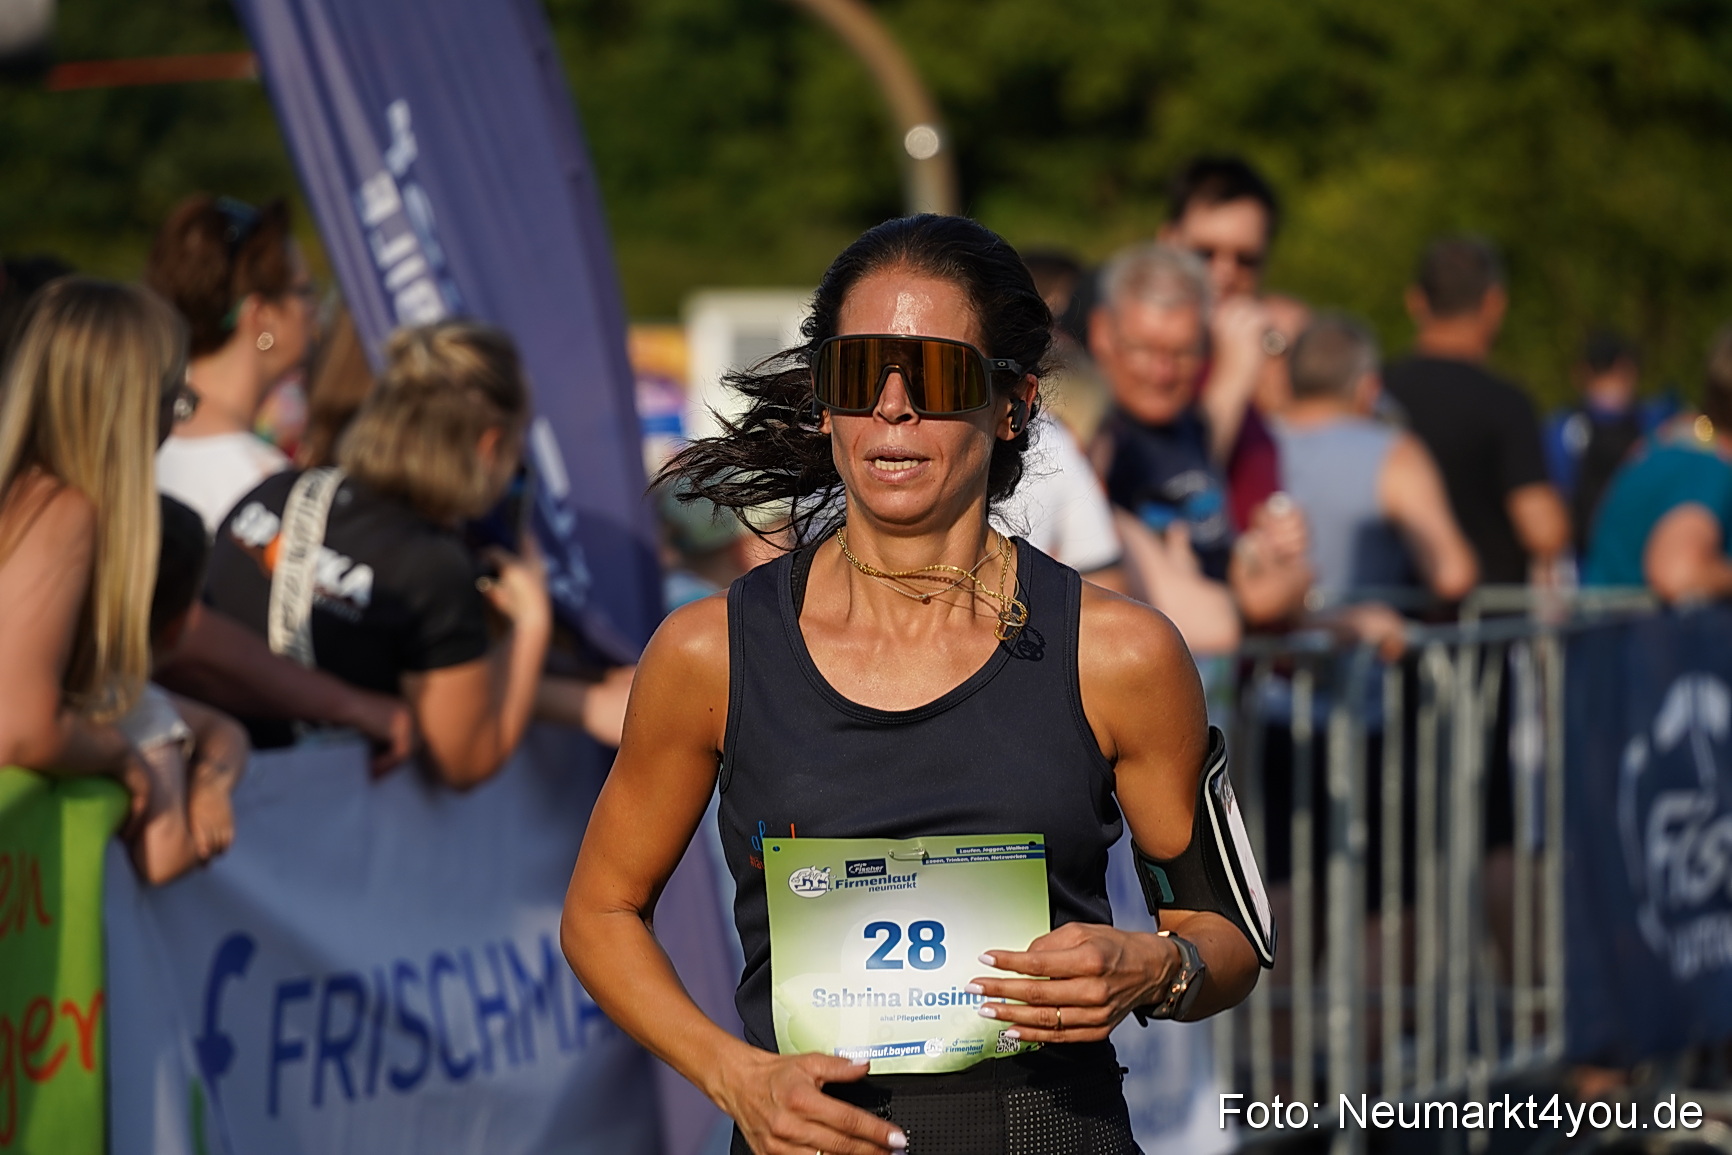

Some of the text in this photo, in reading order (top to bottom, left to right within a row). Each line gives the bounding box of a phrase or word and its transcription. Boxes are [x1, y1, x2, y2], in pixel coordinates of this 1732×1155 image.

[835, 873, 917, 889] Firmenlauf
[869, 881, 917, 892] neumarkt
[863, 920, 947, 970] 28
[812, 987, 902, 1008] Sabrina
[267, 932, 606, 1118] FRISCHMA
[897, 1013, 941, 1022] Pflegedienst
[838, 1045, 921, 1059] firmenlauf.bayern
[945, 1044, 984, 1053] Firmenlauf
